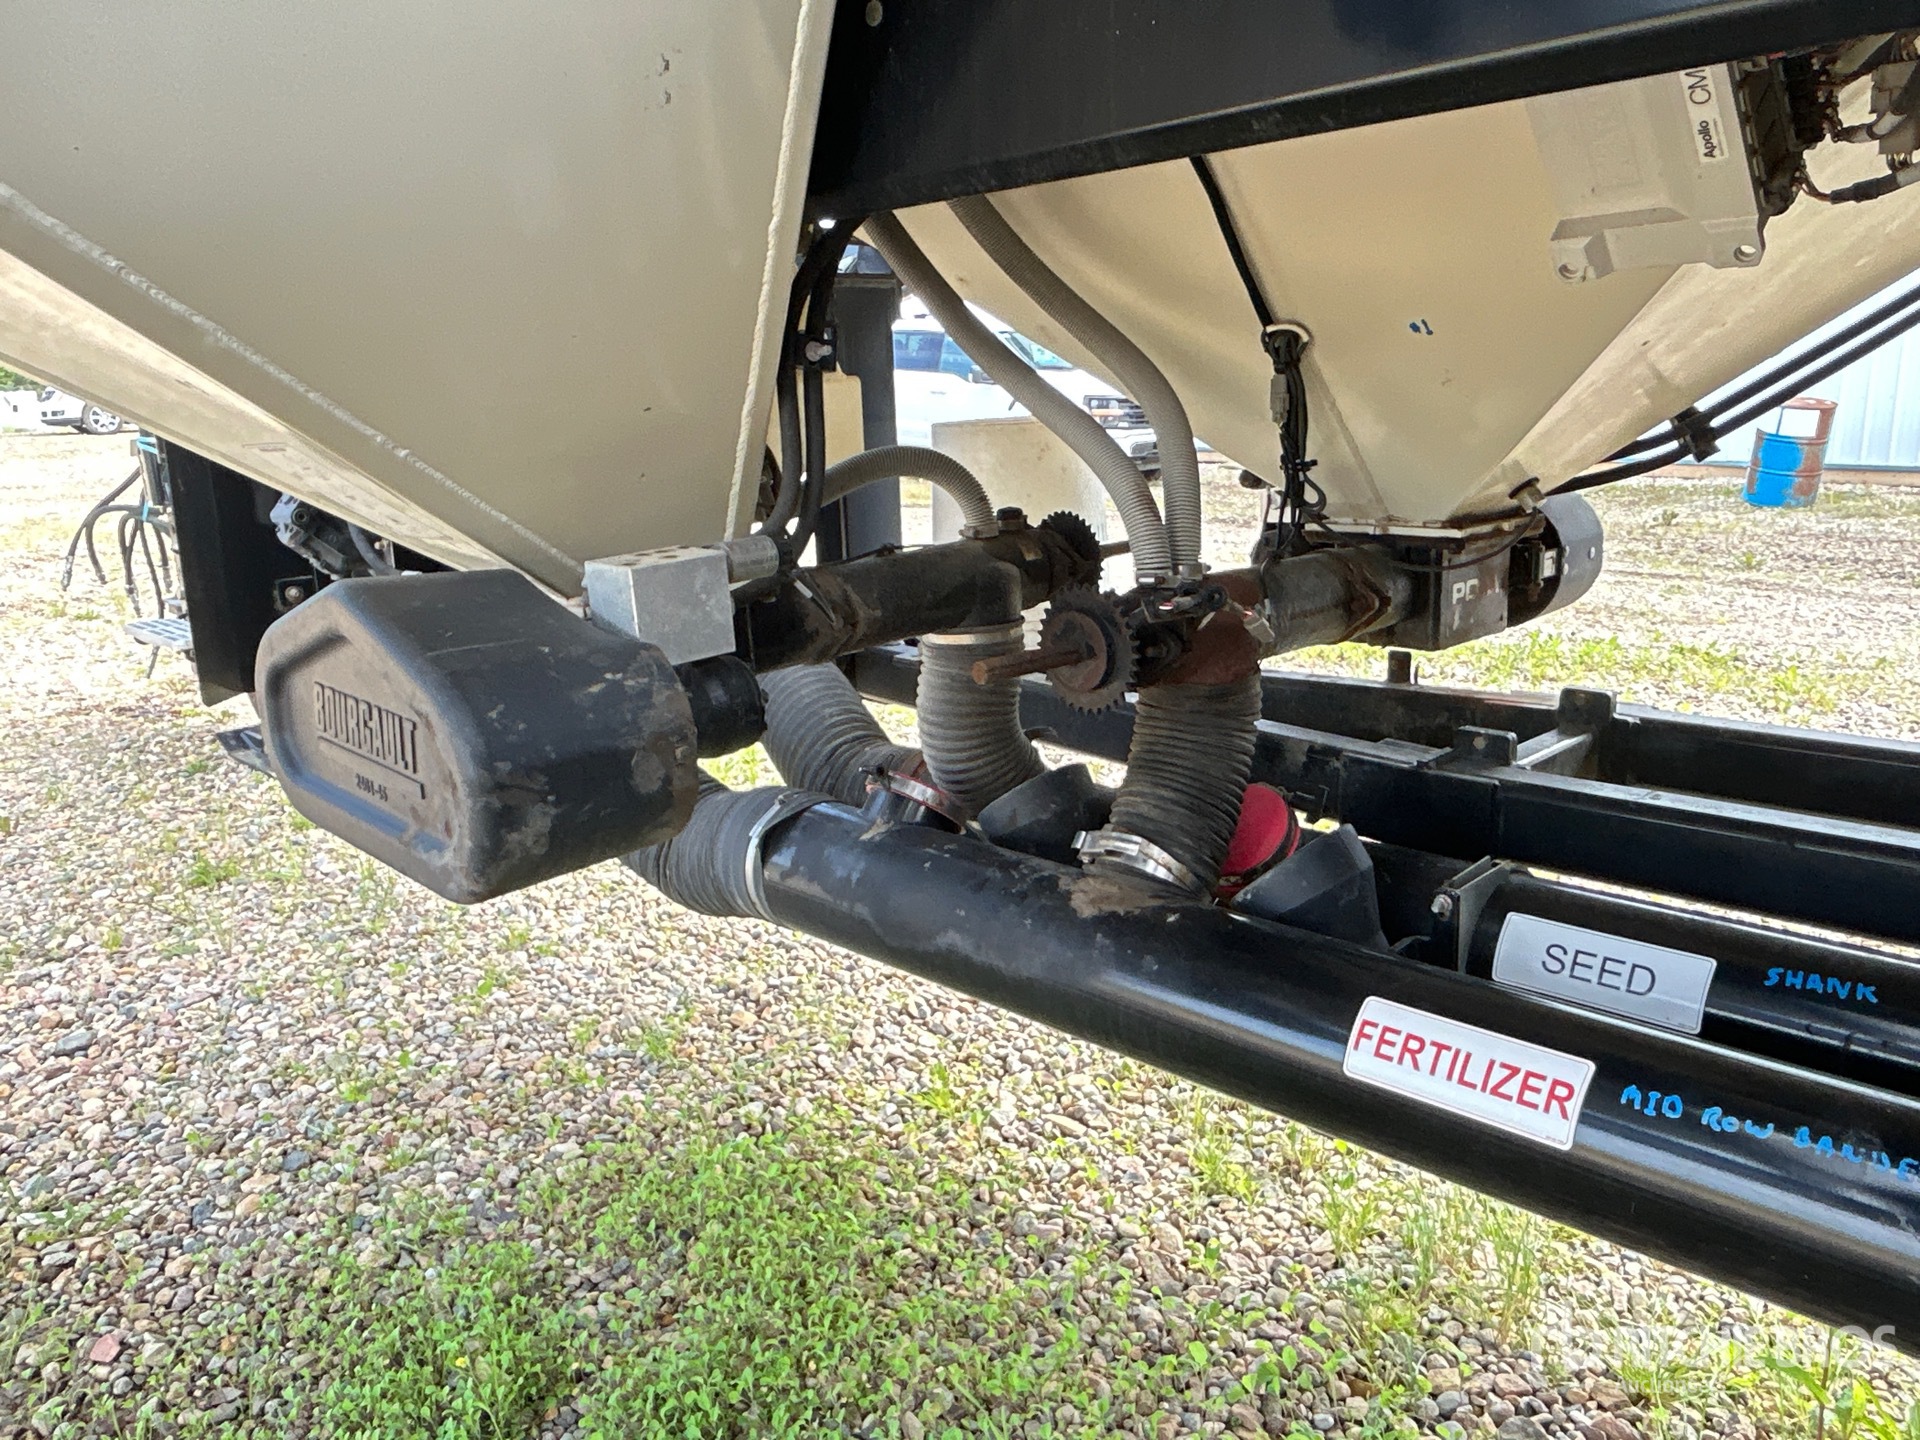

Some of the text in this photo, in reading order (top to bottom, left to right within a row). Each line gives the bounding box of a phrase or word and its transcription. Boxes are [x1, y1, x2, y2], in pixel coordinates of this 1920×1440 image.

[1699, 120, 1716, 158] Apollo
[314, 681, 417, 774] BOURGAULT
[1541, 943, 1657, 998] SEED
[1764, 966, 1879, 1004] SHANK
[1353, 1018, 1576, 1122] FERTILIZER
